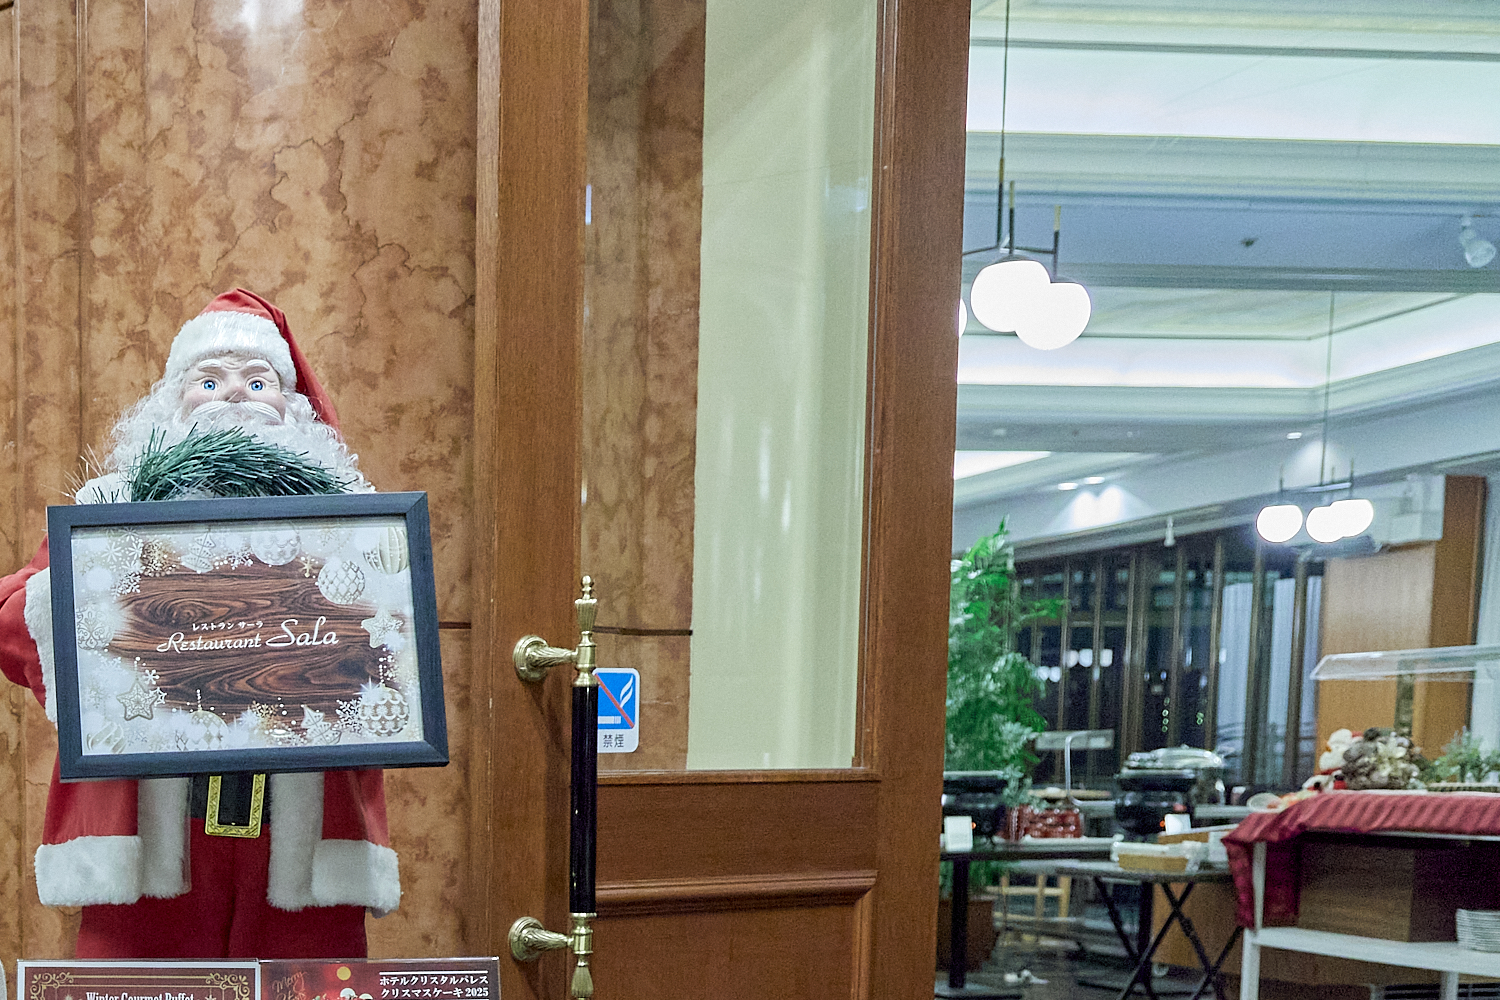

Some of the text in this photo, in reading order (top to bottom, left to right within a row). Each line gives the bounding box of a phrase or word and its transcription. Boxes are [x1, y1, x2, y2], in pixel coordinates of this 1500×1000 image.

[192, 621, 264, 632] レストラン サーラ
[156, 615, 339, 654] Restaurant Sala
[603, 734, 624, 748] 禁煙
[380, 975, 489, 986] ホテルクリスタルパレス
[381, 987, 489, 998] クリスマスケーキ 2025
